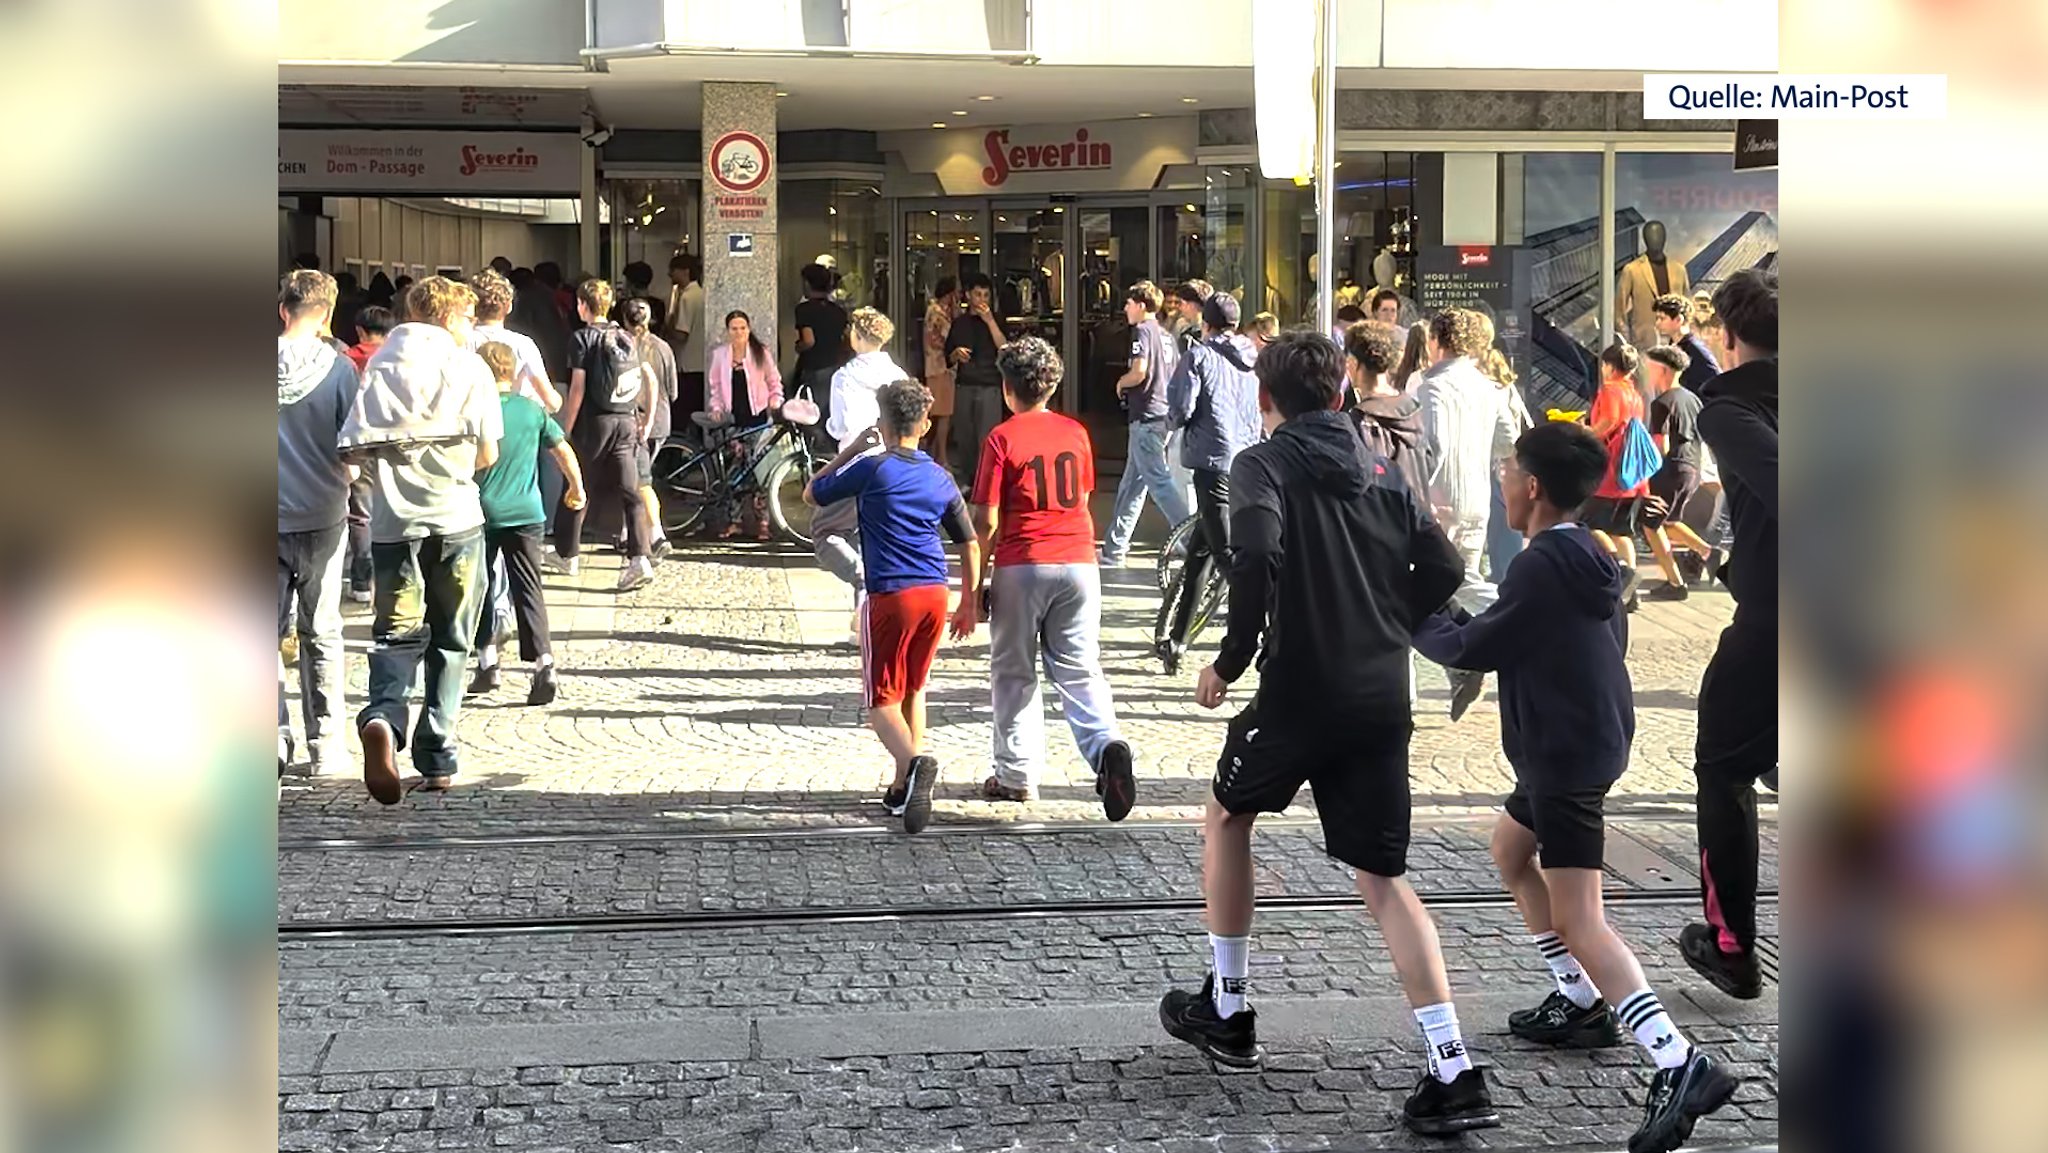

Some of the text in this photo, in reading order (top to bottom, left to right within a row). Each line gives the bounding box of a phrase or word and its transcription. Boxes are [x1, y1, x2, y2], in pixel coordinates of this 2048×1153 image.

[328, 144, 424, 157] Willkommen in der
[982, 127, 1111, 187] Severin
[326, 160, 358, 174] Dom
[369, 160, 425, 177] Passage
[459, 144, 538, 176] Severin
[1423, 273, 1468, 281] MODE MIT
[1423, 291, 1444, 299] SEIT
[1469, 291, 1480, 299] IN
[1025, 451, 1079, 511] 10
